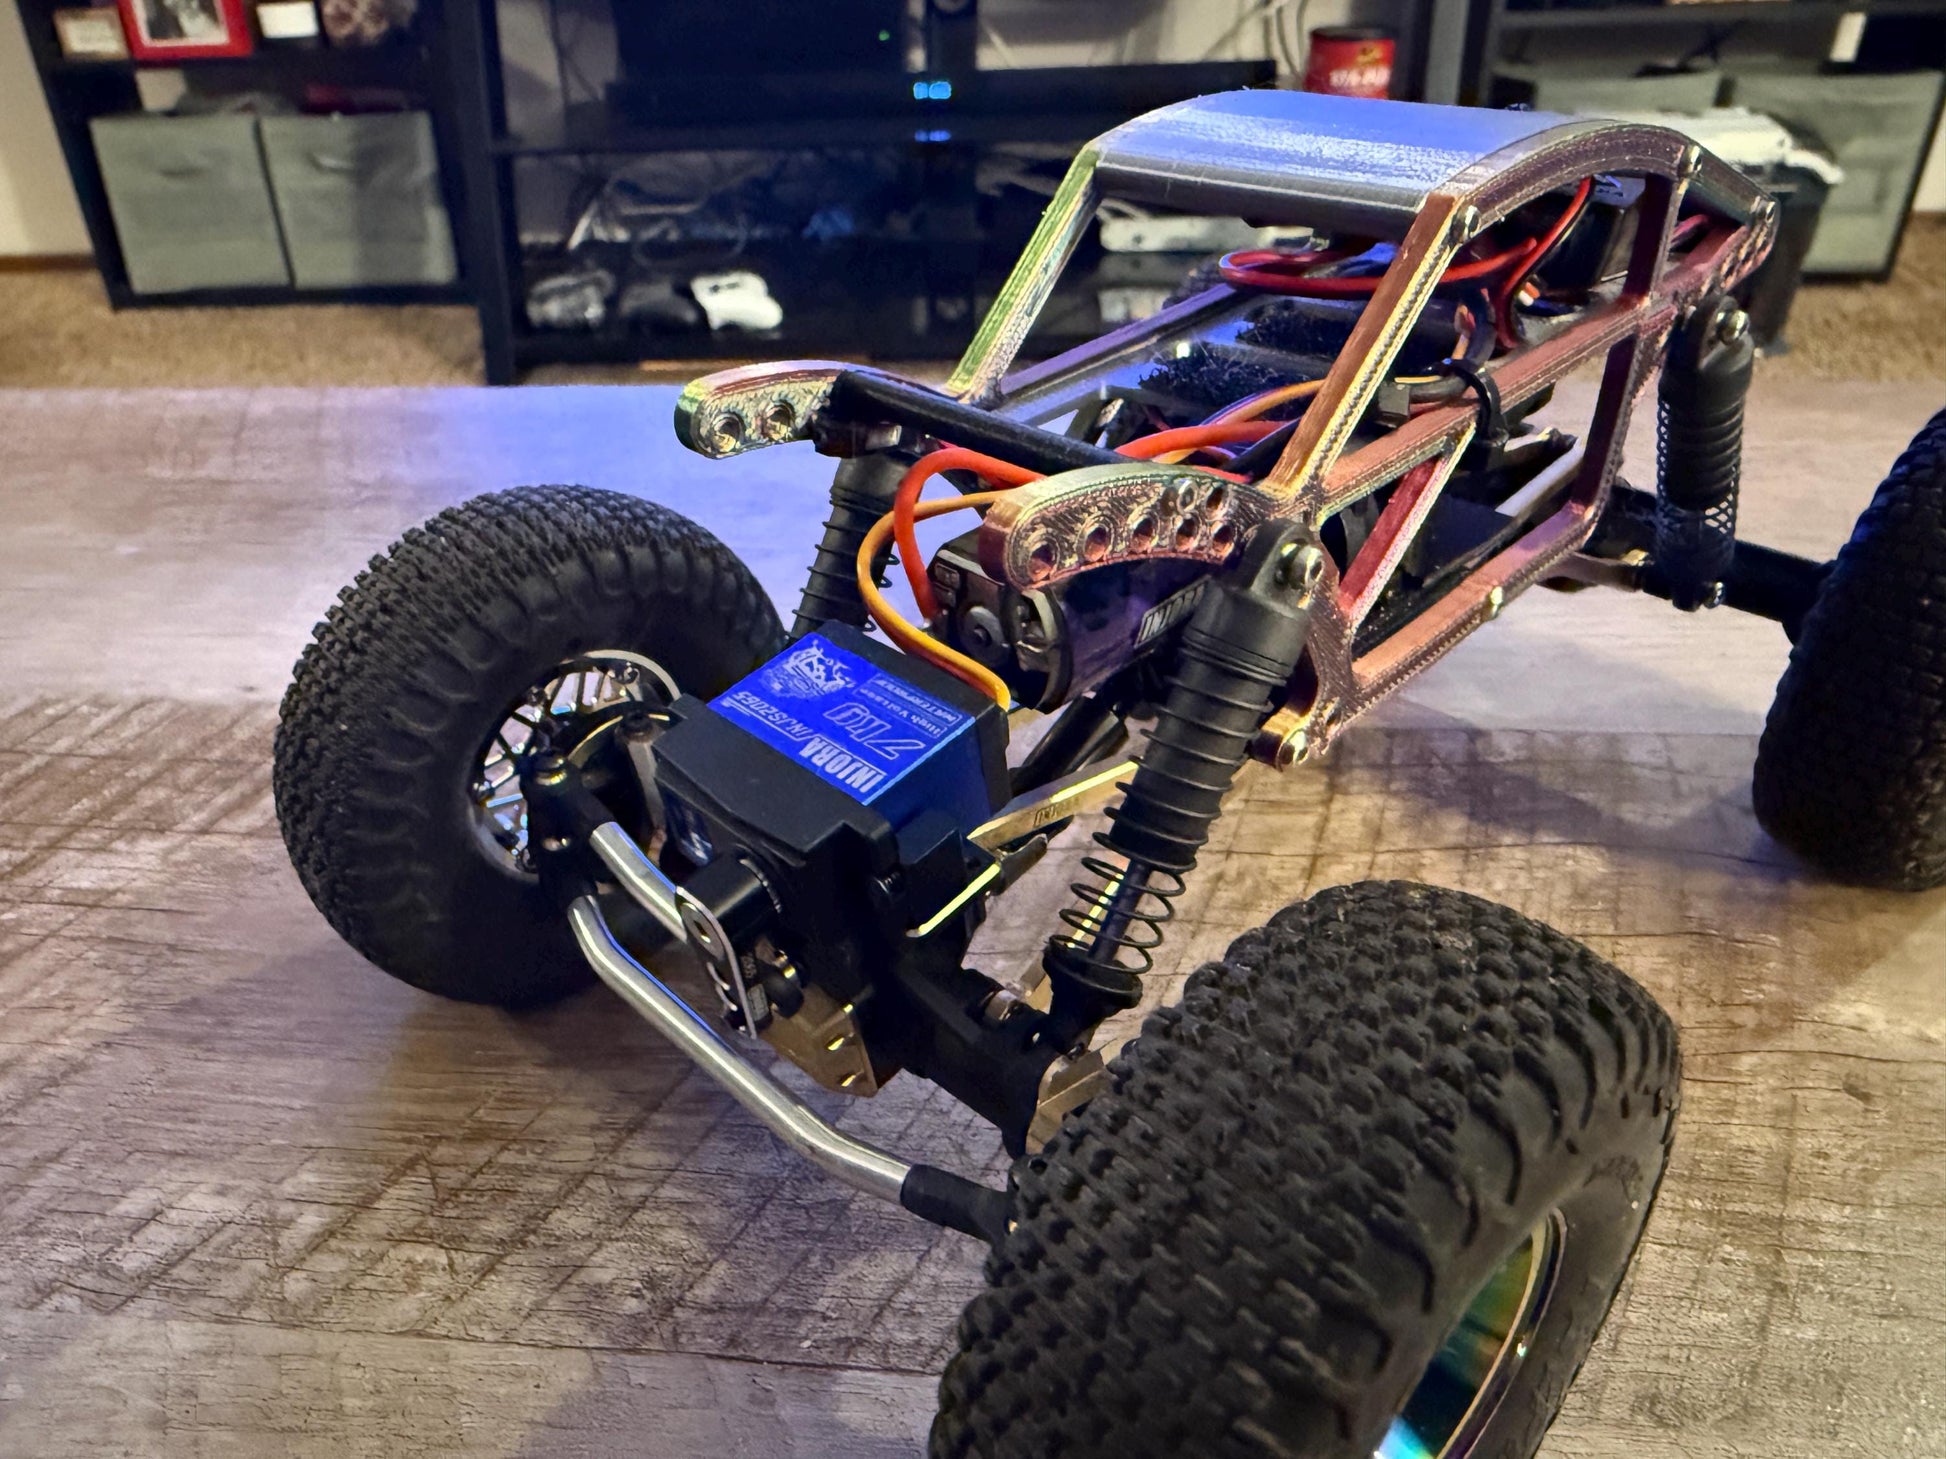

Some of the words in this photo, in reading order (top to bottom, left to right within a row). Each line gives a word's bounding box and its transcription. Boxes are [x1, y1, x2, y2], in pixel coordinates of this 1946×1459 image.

[732, 691, 814, 736] INJS2065
[822, 702, 927, 761] 7kg
[911, 715, 941, 735] High
[799, 737, 885, 793] INJORA
